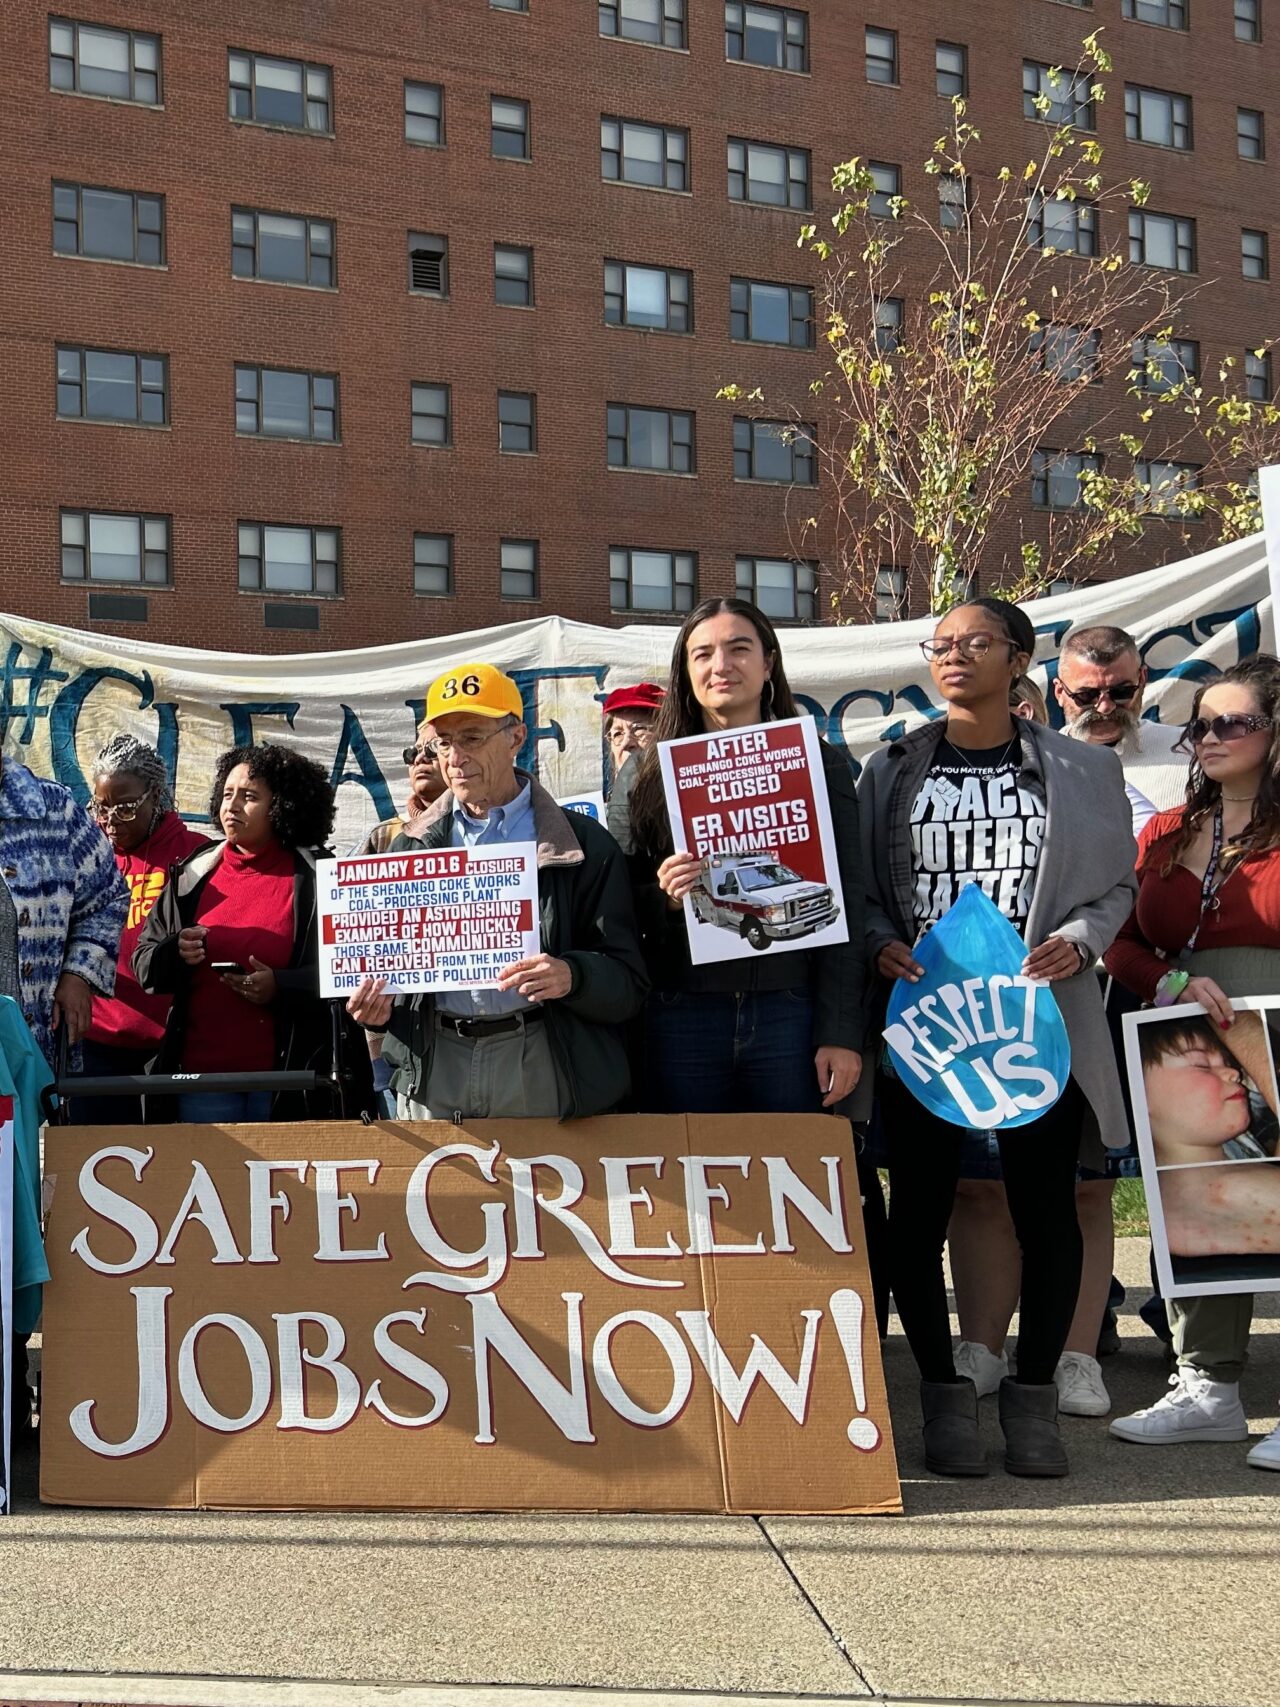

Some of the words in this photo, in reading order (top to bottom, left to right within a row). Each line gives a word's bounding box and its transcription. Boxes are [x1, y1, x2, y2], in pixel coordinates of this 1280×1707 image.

[442, 675, 480, 699] 36
[707, 731, 768, 760] AFTER
[678, 766, 772, 790] COAL-PROCESSING
[774, 757, 806, 774] PLANT
[679, 759, 733, 778] SHENANGO
[735, 754, 761, 768] COKE
[764, 746, 802, 762] WORKS
[707, 774, 781, 804] CLOSED
[692, 812, 724, 840] ER
[728, 799, 808, 834] VISITS
[696, 823, 810, 858] PLUMMETED
[414, 855, 460, 876] 2016
[465, 858, 522, 875] CLOSURE
[330, 887, 345, 900] OF
[348, 886, 369, 899] THE
[372, 880, 435, 897] SHENANGO
[439, 877, 470, 893] COKE
[474, 874, 520, 888] WORKS
[349, 890, 459, 912] COAL-PROCESSING
[463, 888, 501, 902] PLANT
[331, 910, 398, 929] PROVIDED
[402, 908, 422, 923] AN
[425, 900, 521, 921] ASTONISHING
[334, 944, 370, 958] THOSE
[374, 941, 408, 956] SAME
[411, 931, 521, 954] COMMUNITIES
[335, 925, 398, 944] EXAMPLE
[401, 924, 418, 938] OF
[423, 921, 457, 937] HOW
[460, 917, 520, 935] QUICKLY
[332, 958, 362, 974] CAN
[366, 953, 432, 971] RECOVER
[436, 954, 467, 967] FROM
[470, 953, 489, 965] THE
[493, 951, 525, 964] MOST
[334, 973, 361, 988] DIRE
[364, 971, 420, 985] PACTS
[424, 968, 439, 983] OF
[443, 965, 504, 983] POLLUTIO
[881, 974, 1050, 1085] RESPECT
[940, 1043, 1059, 1129] US
[70, 1143, 391, 1276] SAFE
[403, 1139, 855, 1293] GREEN
[69, 1285, 451, 1458] JOBS
[466, 1287, 882, 1453] NOW!
